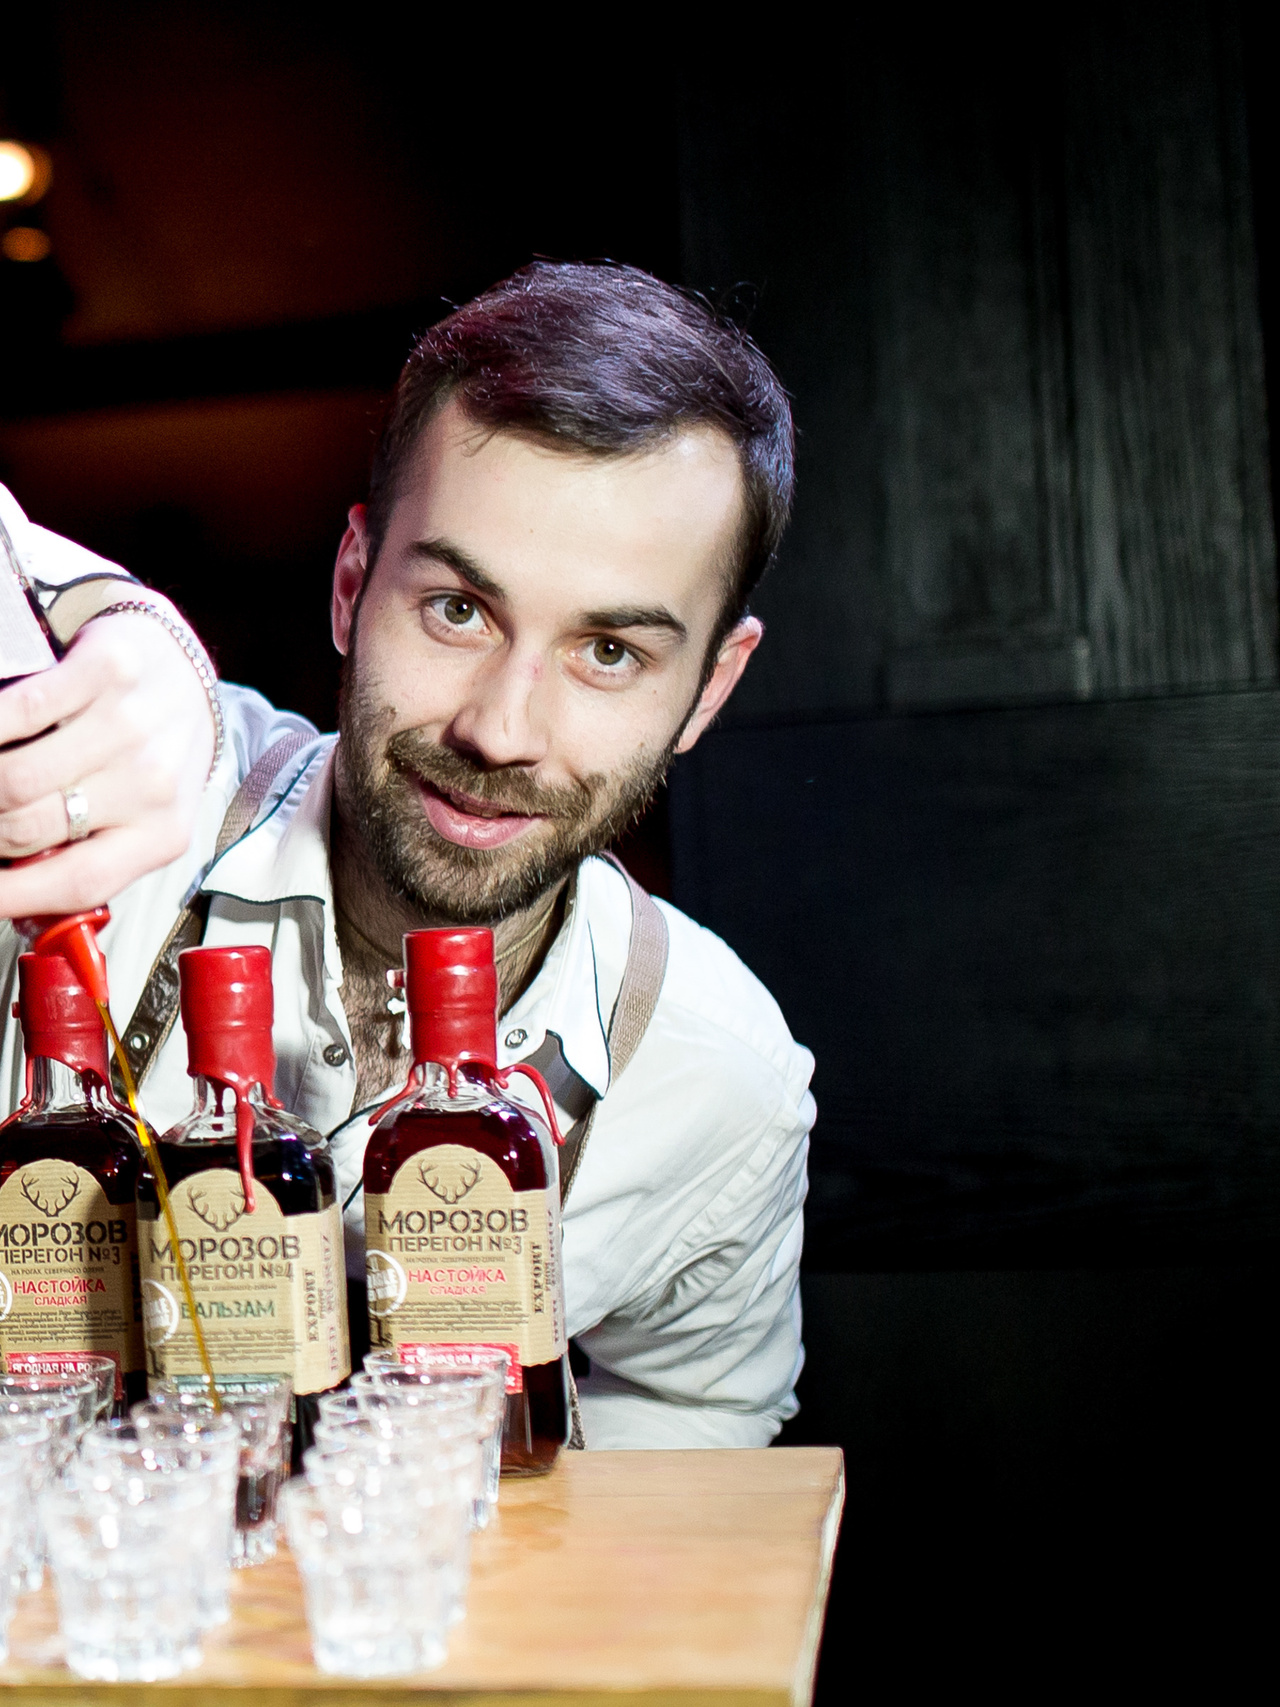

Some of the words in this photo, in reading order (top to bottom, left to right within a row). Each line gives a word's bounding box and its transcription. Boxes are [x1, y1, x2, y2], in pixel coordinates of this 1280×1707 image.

[378, 1209, 529, 1234] МОРОЗОВ
[150, 1235, 301, 1263] МОРОЗОВ
[390, 1236, 485, 1252] ПЕРЕГОН
[161, 1263, 253, 1281] ПРЕГОН
[408, 1266, 507, 1284] НАСТОЙКА
[530, 1241, 544, 1314] EXPORT
[14, 1276, 106, 1294] НАСТОЙКА
[428, 1285, 487, 1296] СЛАДКАЯ
[34, 1295, 87, 1307] СЛАДКАЯ
[181, 1300, 275, 1319] БАЛЬЗАМ
[302, 1268, 319, 1341] EXPORT
[12, 1362, 59, 1375] ЯГОДНАЯ
[60, 1362, 76, 1374] НА
